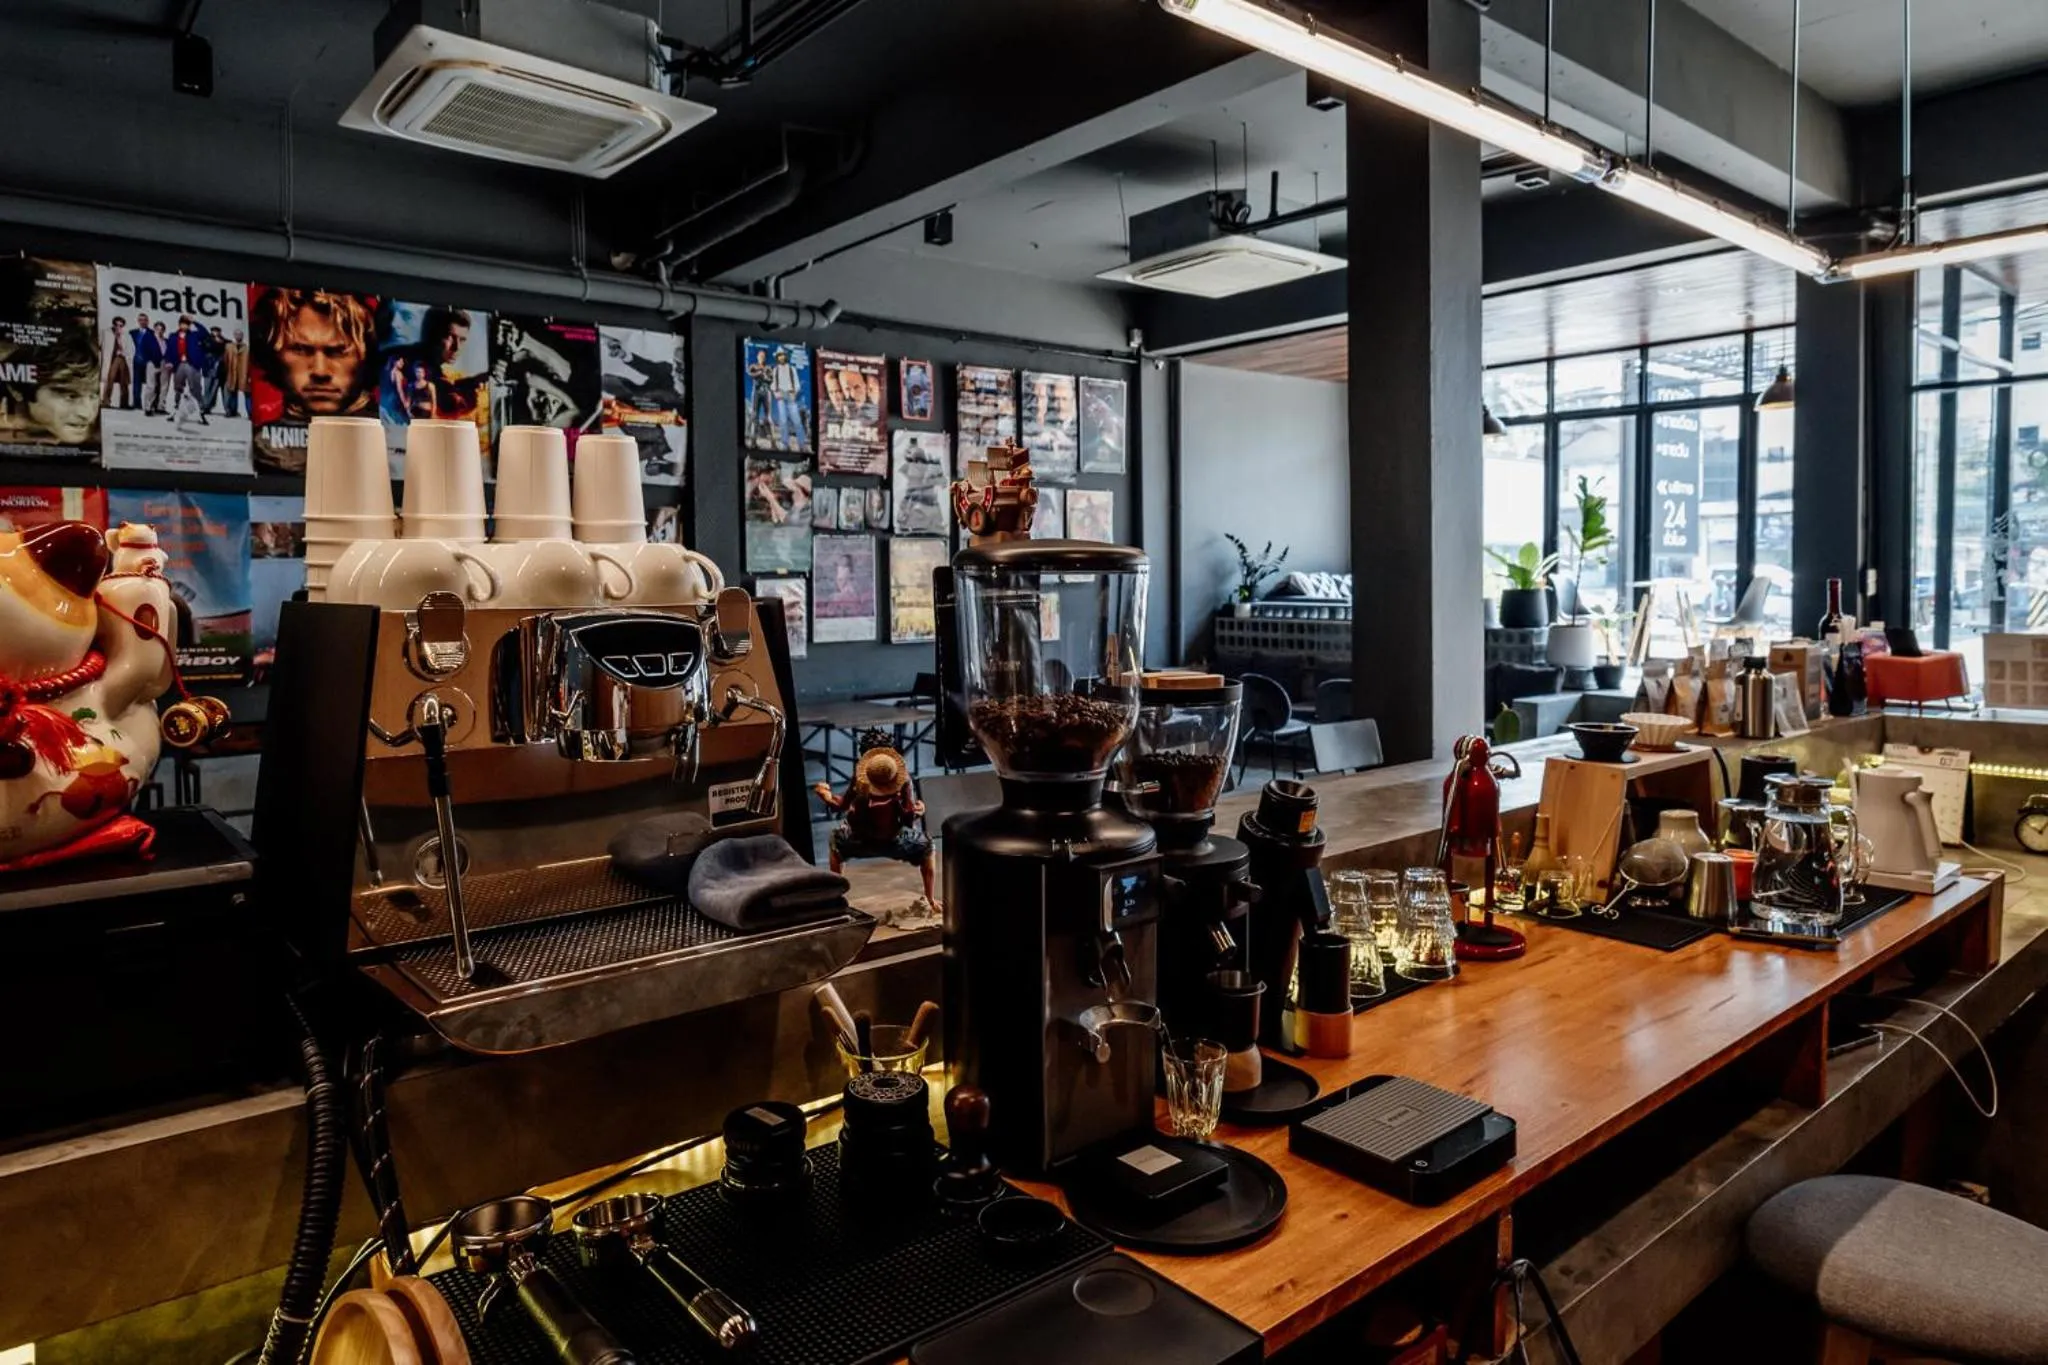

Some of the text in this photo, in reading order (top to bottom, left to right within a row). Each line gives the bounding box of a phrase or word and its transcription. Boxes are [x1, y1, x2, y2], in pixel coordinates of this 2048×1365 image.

[109, 282, 243, 320] snatch
[262, 426, 270, 439] A
[1663, 499, 1687, 529] 24
